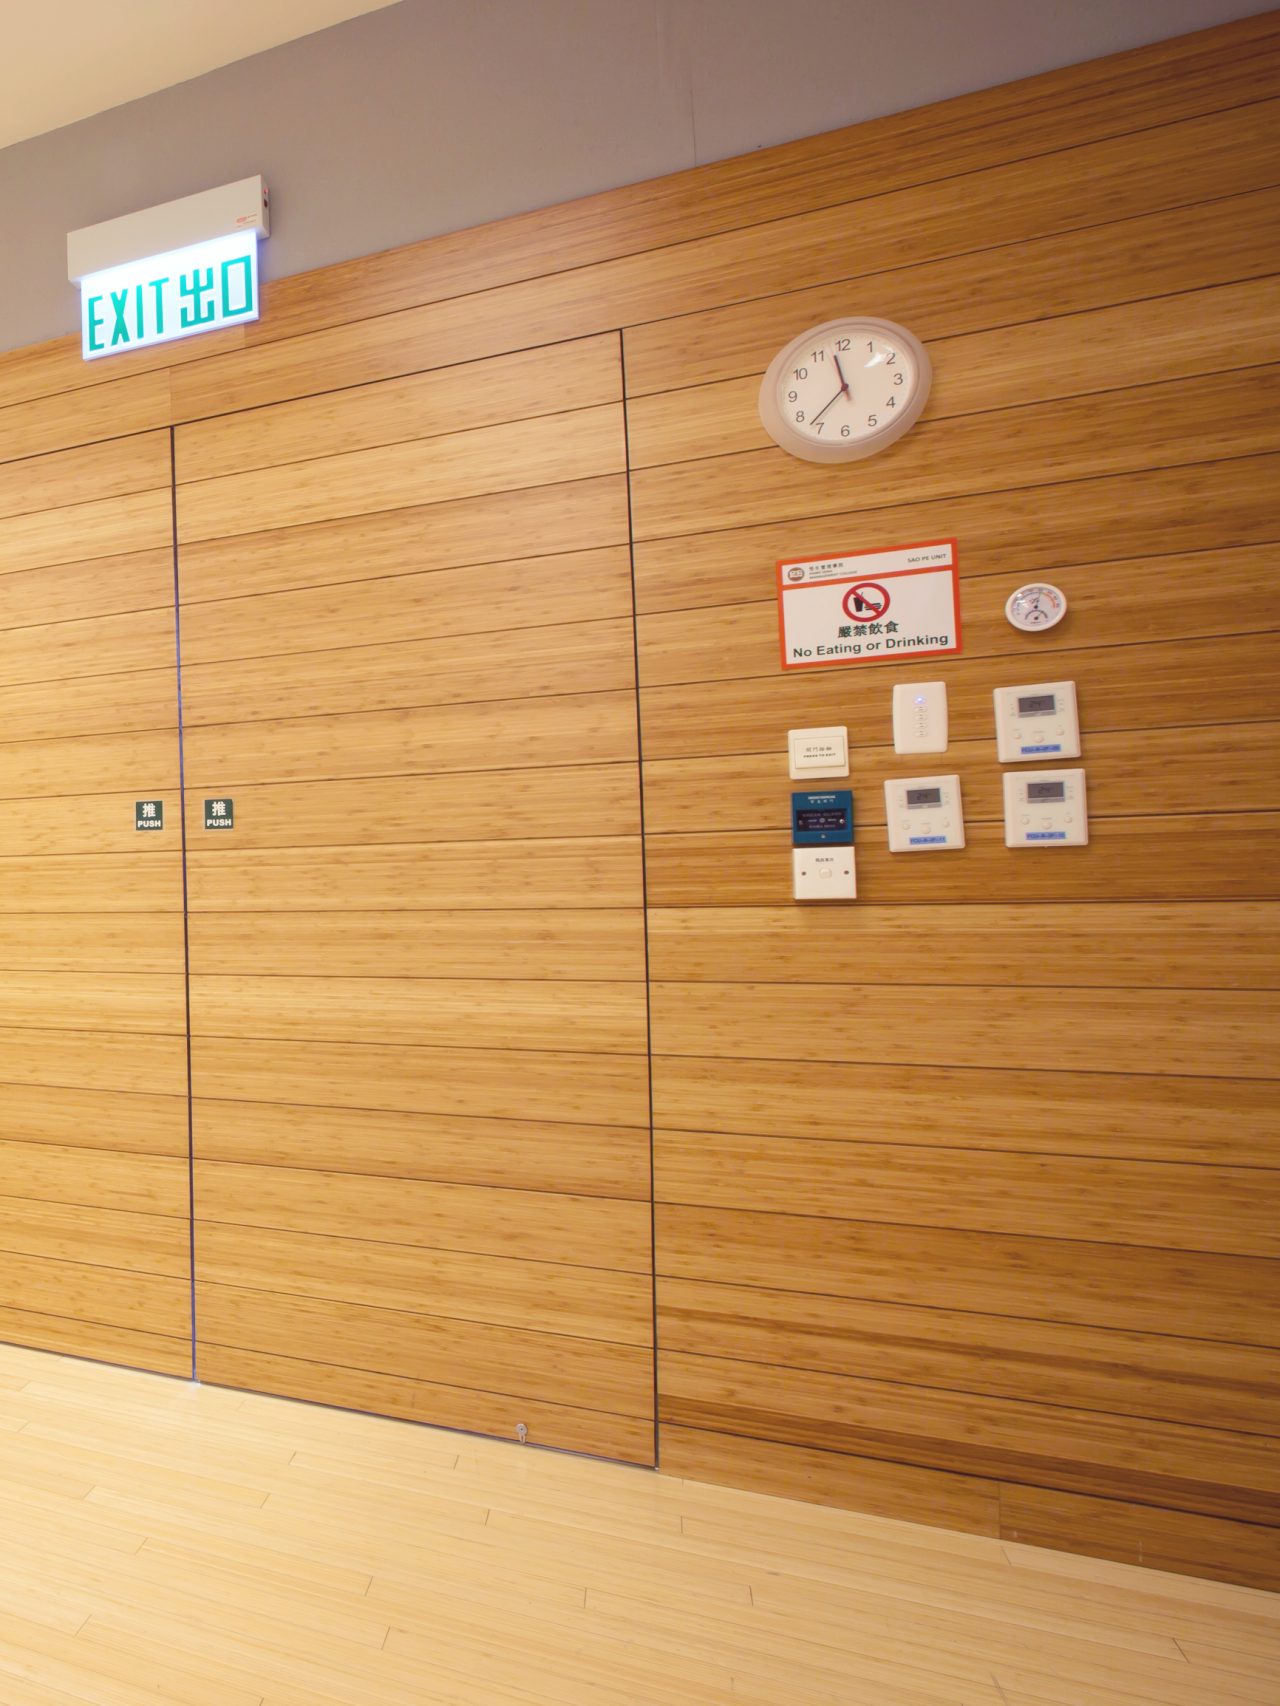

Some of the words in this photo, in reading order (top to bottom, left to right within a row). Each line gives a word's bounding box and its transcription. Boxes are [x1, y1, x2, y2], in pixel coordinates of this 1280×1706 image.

[88, 277, 170, 352] EXIT
[179, 254, 253, 329] 出口
[835, 338, 851, 352] 12
[810, 349, 825, 363] 11
[885, 352, 896, 365] 2
[793, 367, 808, 381] 10
[893, 372, 903, 386] 3
[787, 390, 798, 403] 9
[885, 396, 897, 409] 4
[795, 410, 805, 423] 8
[867, 414, 878, 427] 5
[815, 421, 825, 435] 7
[840, 424, 850, 438] 6
[837, 620, 899, 639] 嚴禁飲食
[793, 647, 812, 658] No
[816, 642, 861, 656] Eating
[866, 640, 882, 651] or
[886, 633, 949, 649] Drinking
[142, 803, 156, 817] 推
[212, 801, 226, 816] 推
[137, 820, 161, 828] PUSH
[206, 818, 232, 827] PUSH
